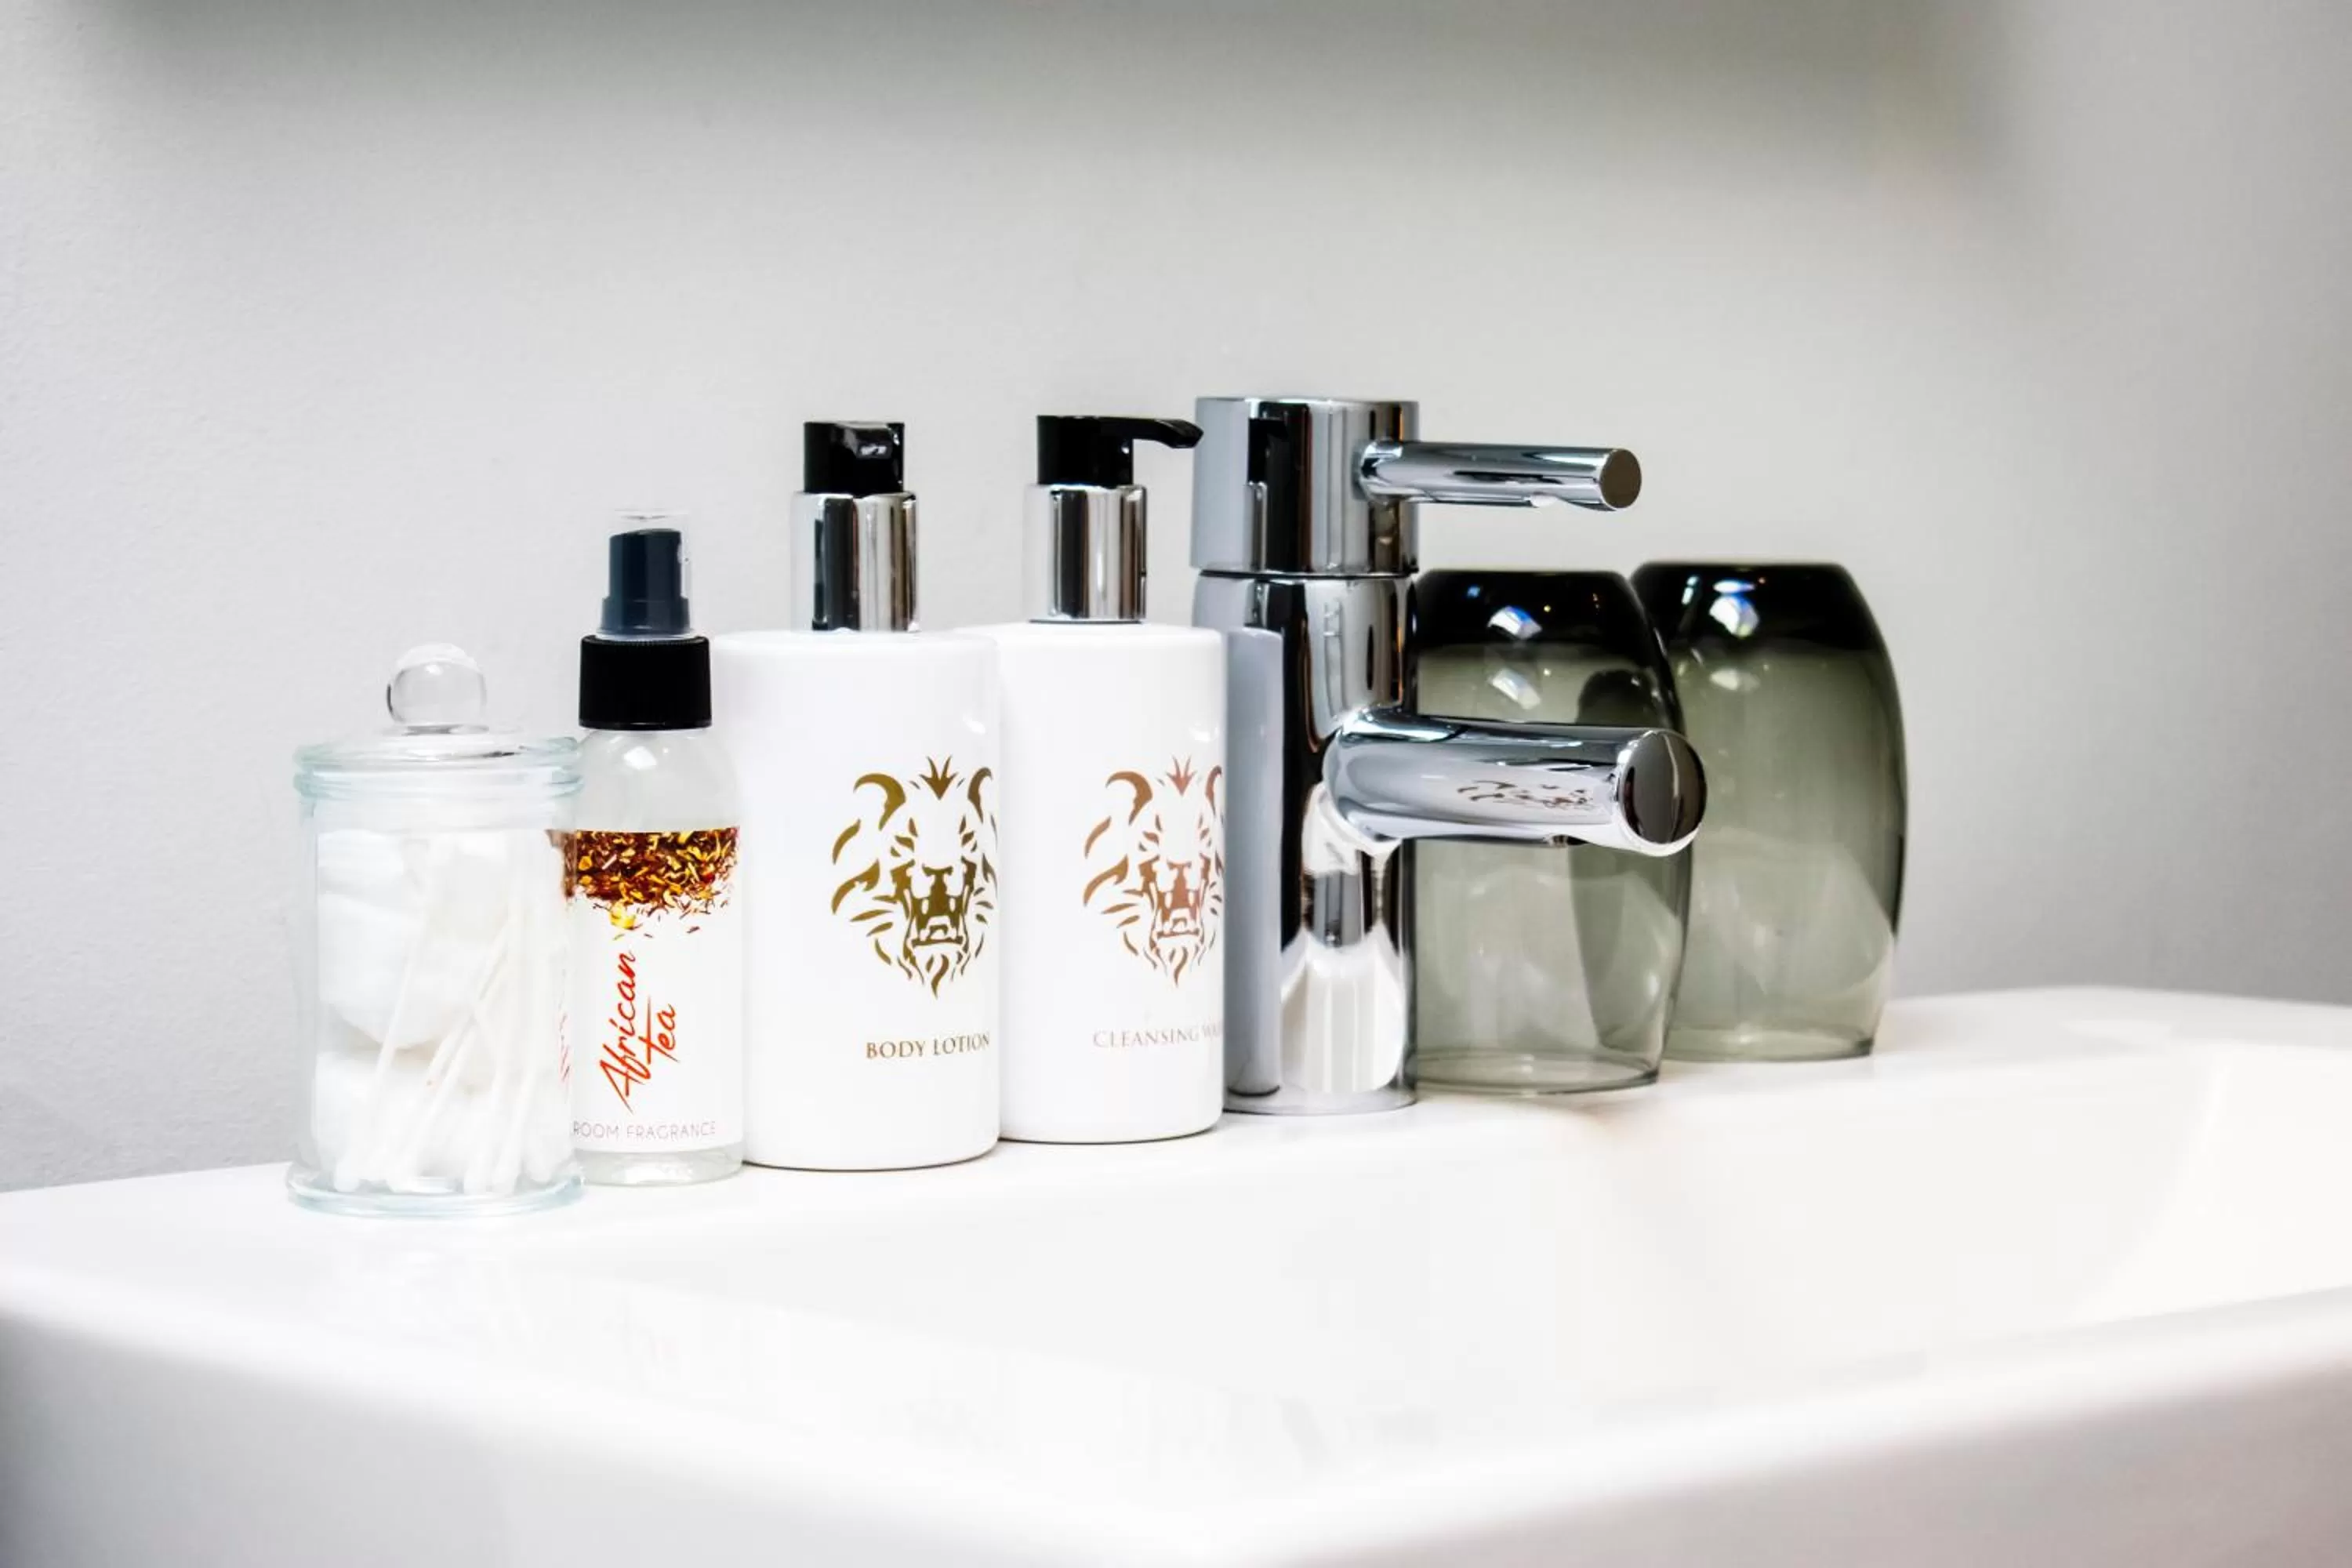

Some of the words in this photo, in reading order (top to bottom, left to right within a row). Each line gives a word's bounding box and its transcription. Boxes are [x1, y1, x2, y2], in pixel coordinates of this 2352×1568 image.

[599, 949, 651, 1114] African
[1093, 1027, 1199, 1048] CLEANSING
[866, 1040, 926, 1059] BODY
[933, 1031, 990, 1056] LOTION
[573, 1120, 619, 1139] ROOM
[626, 1121, 716, 1140] FRAGRANCE
